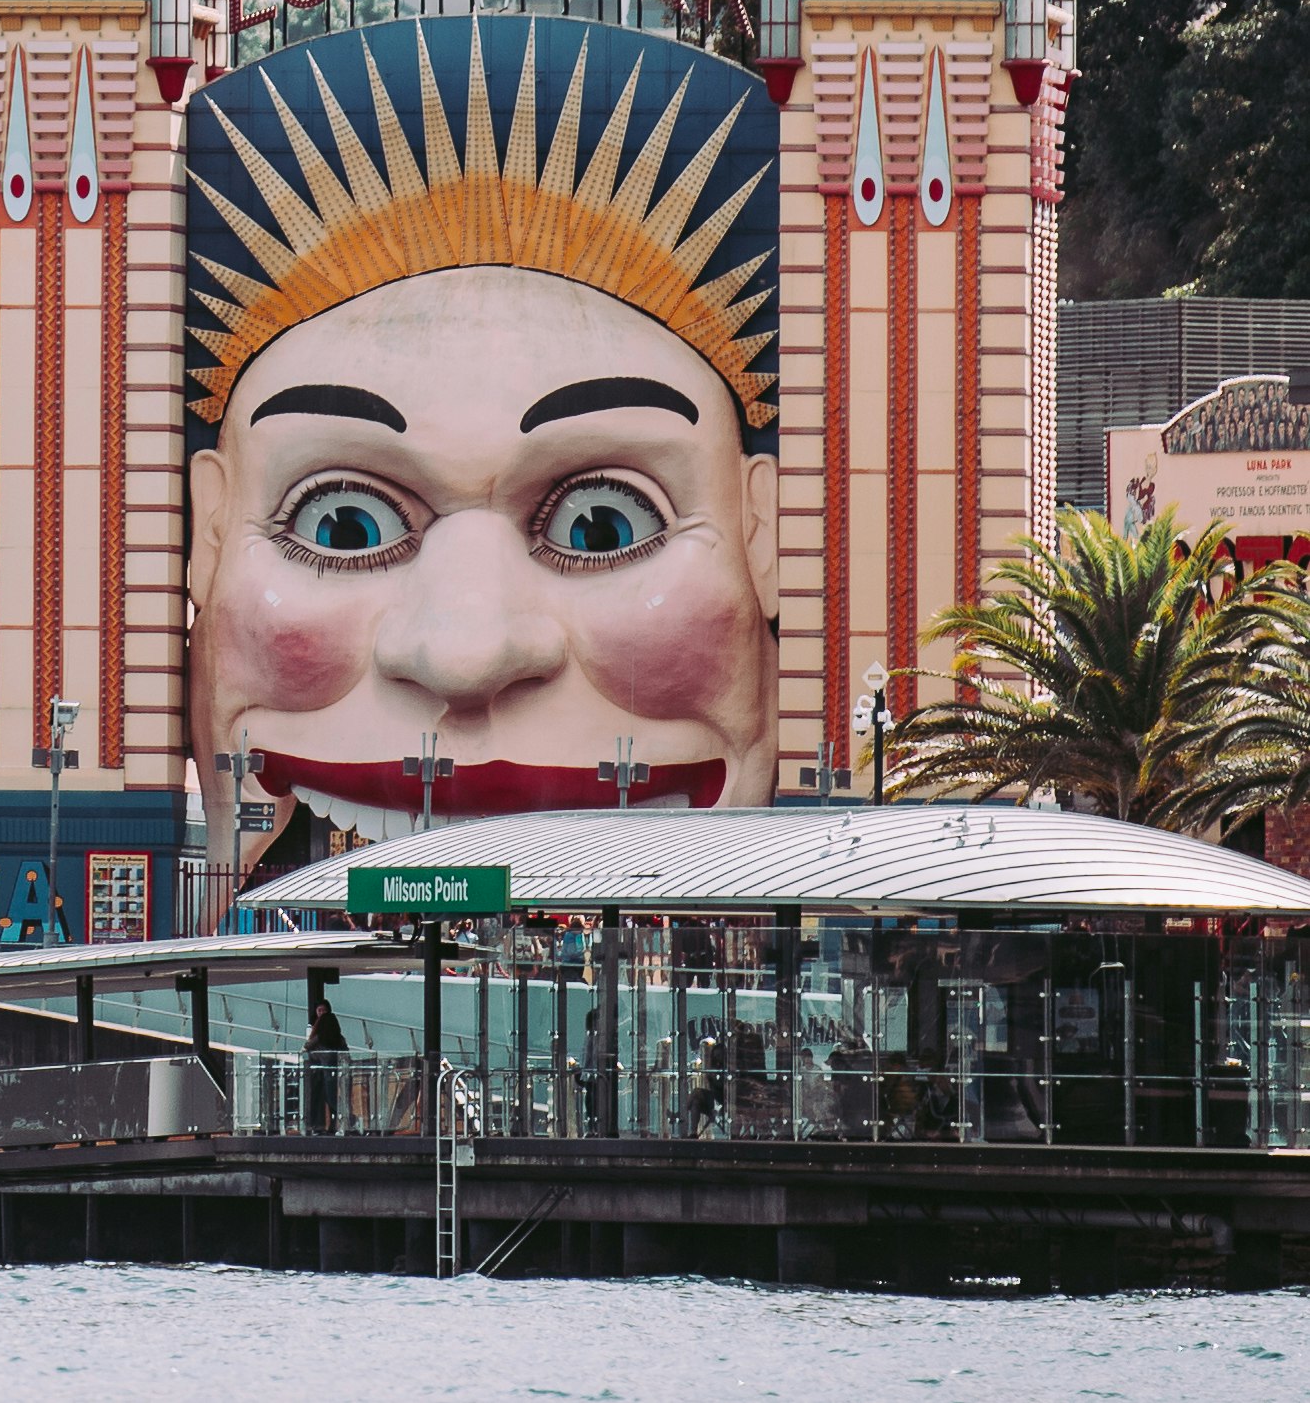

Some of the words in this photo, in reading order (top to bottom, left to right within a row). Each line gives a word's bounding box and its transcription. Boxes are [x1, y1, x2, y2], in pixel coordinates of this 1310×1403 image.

[1246, 459, 1268, 471] LUNA
[1271, 459, 1292, 470] PARK
[1216, 485, 1256, 498] PROFESSOR
[1210, 506, 1235, 518] WORLD
[1240, 505, 1266, 517] FAMOUS
[1268, 504, 1303, 516] SCIENTIFIC
[383, 875, 433, 903] Milsons
[434, 875, 469, 903] Point
